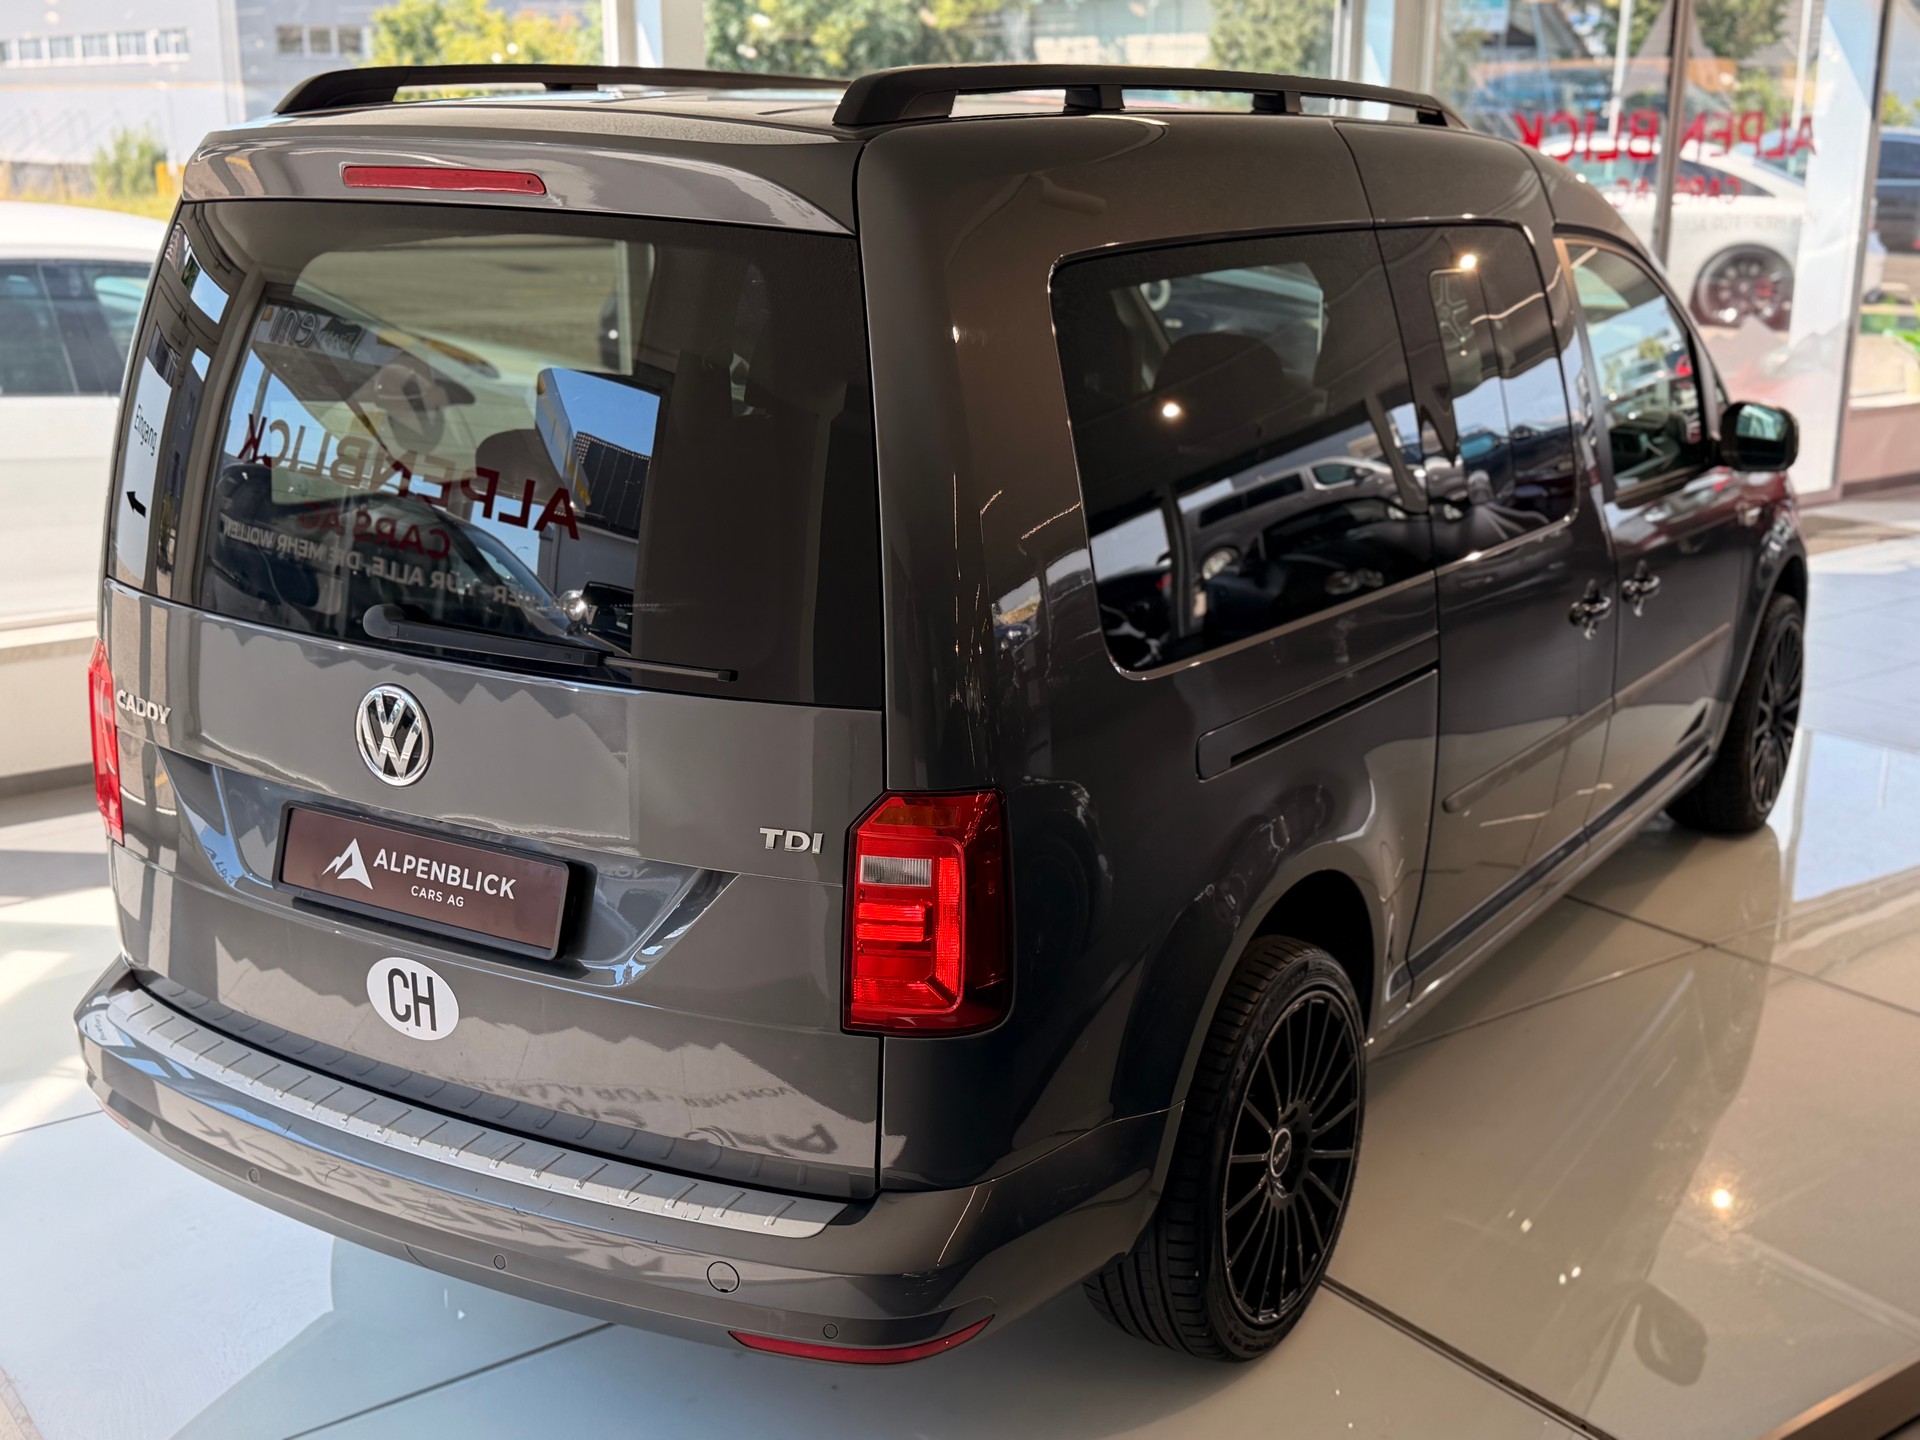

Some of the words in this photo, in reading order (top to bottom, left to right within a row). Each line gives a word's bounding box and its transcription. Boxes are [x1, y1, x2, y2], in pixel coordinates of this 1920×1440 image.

[134, 404, 157, 456] Eingang
[116, 688, 171, 726] CADDY
[355, 683, 433, 787] VW
[759, 826, 824, 855] TDI
[373, 848, 516, 900] ALPENBLICK
[411, 885, 443, 902] CARS
[447, 894, 465, 908] AG
[387, 967, 437, 1032] CH
